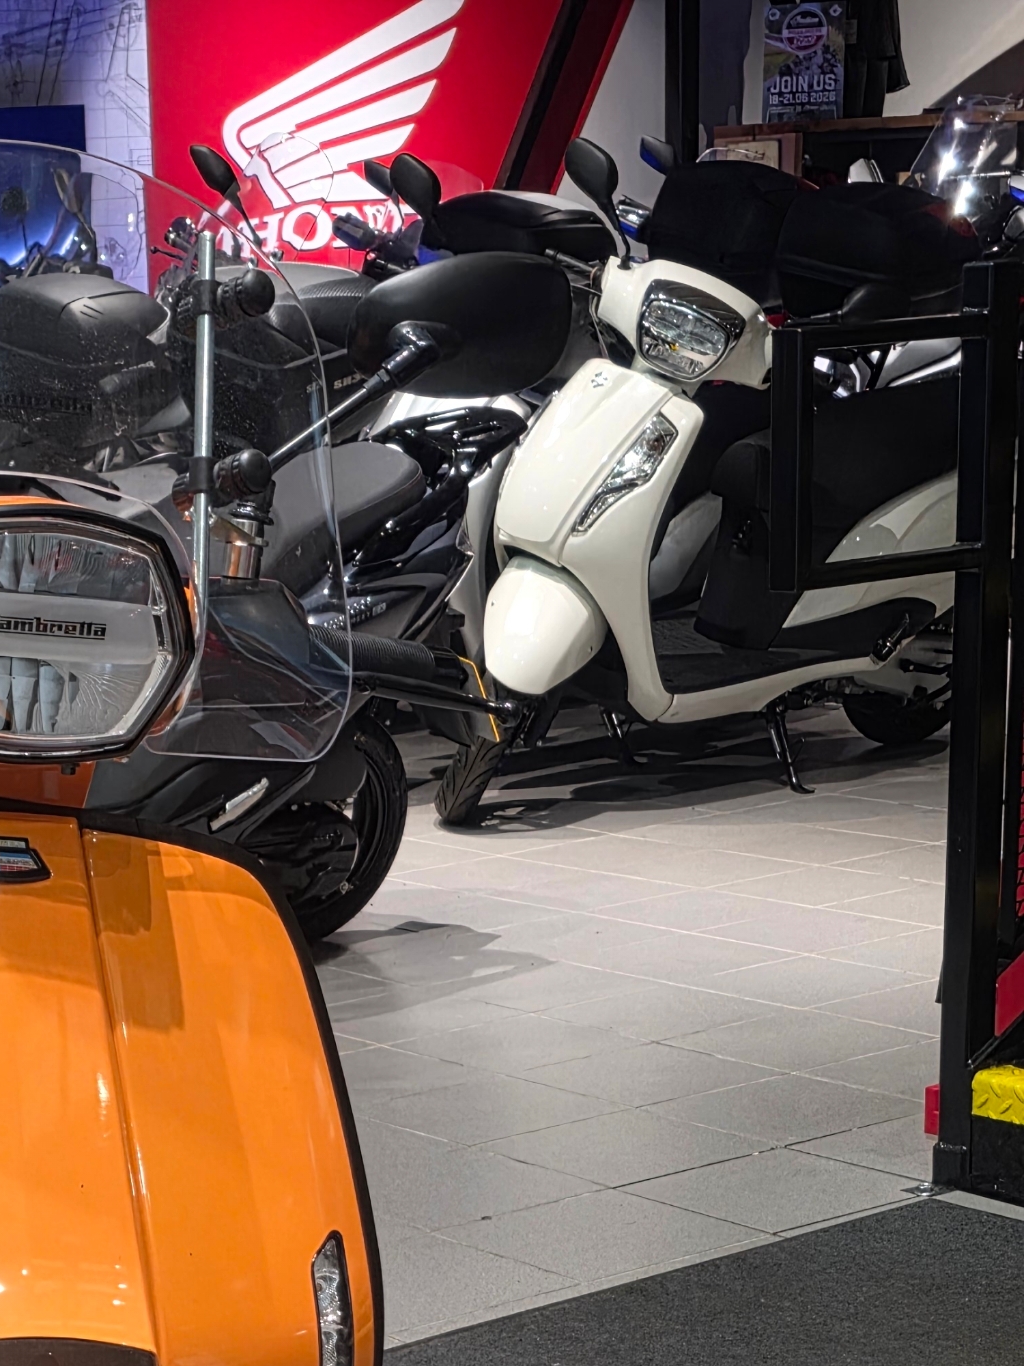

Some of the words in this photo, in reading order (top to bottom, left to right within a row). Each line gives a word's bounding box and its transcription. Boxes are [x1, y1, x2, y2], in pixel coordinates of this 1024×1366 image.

[770, 76, 809, 94] JOIN
[813, 73, 836, 91] US
[810, 91, 836, 102] 2026
